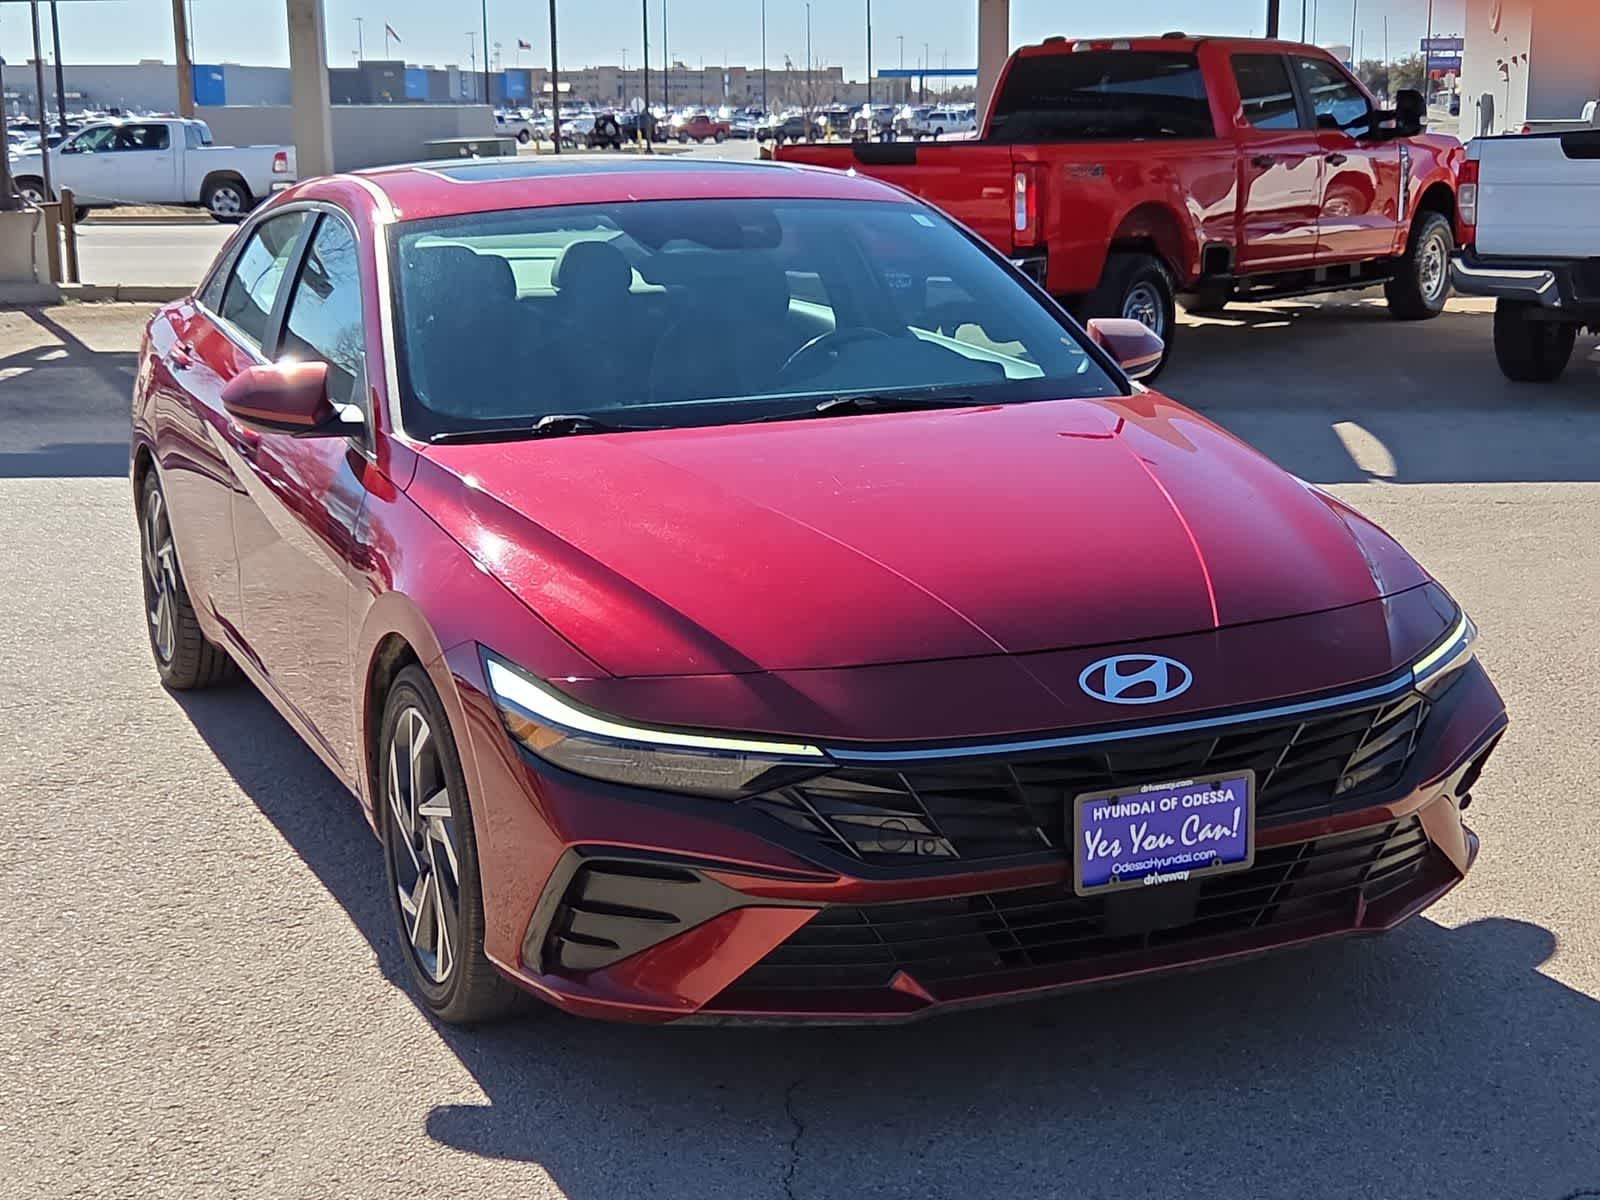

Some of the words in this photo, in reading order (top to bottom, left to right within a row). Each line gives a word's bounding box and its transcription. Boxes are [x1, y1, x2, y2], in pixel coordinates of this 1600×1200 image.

[1093, 800, 1155, 821] HYUNDAI
[1159, 797, 1178, 812] OF
[1182, 789, 1235, 807] ODESSA
[1084, 828, 1122, 861] Yes
[1130, 821, 1175, 854] You
[1180, 806, 1241, 846] Can!
[1111, 849, 1217, 875] OdessaHyundai.com
[1143, 869, 1191, 886] driveway
